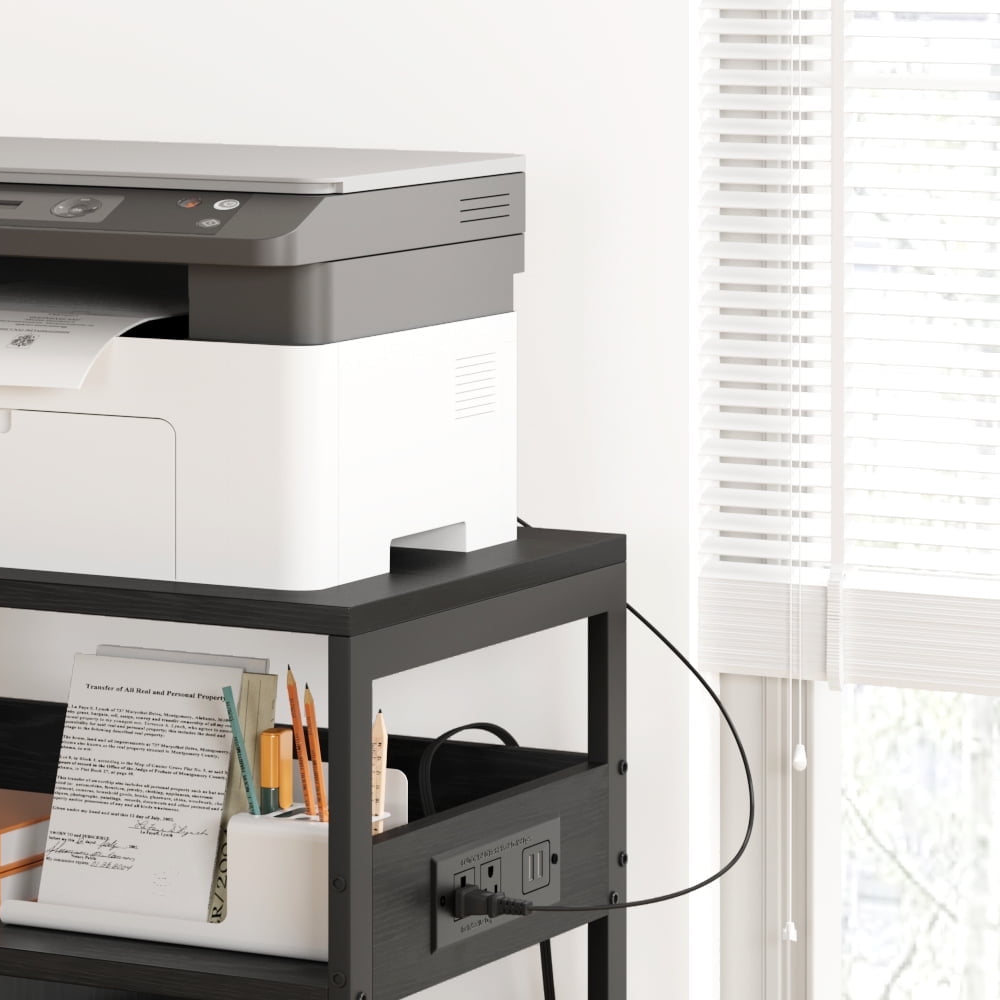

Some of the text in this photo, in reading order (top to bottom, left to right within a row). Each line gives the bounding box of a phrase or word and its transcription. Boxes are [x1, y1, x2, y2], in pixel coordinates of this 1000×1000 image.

[86, 683, 114, 691] Transfer
[166, 690, 196, 699] Personal
[197, 693, 226, 702] Property
